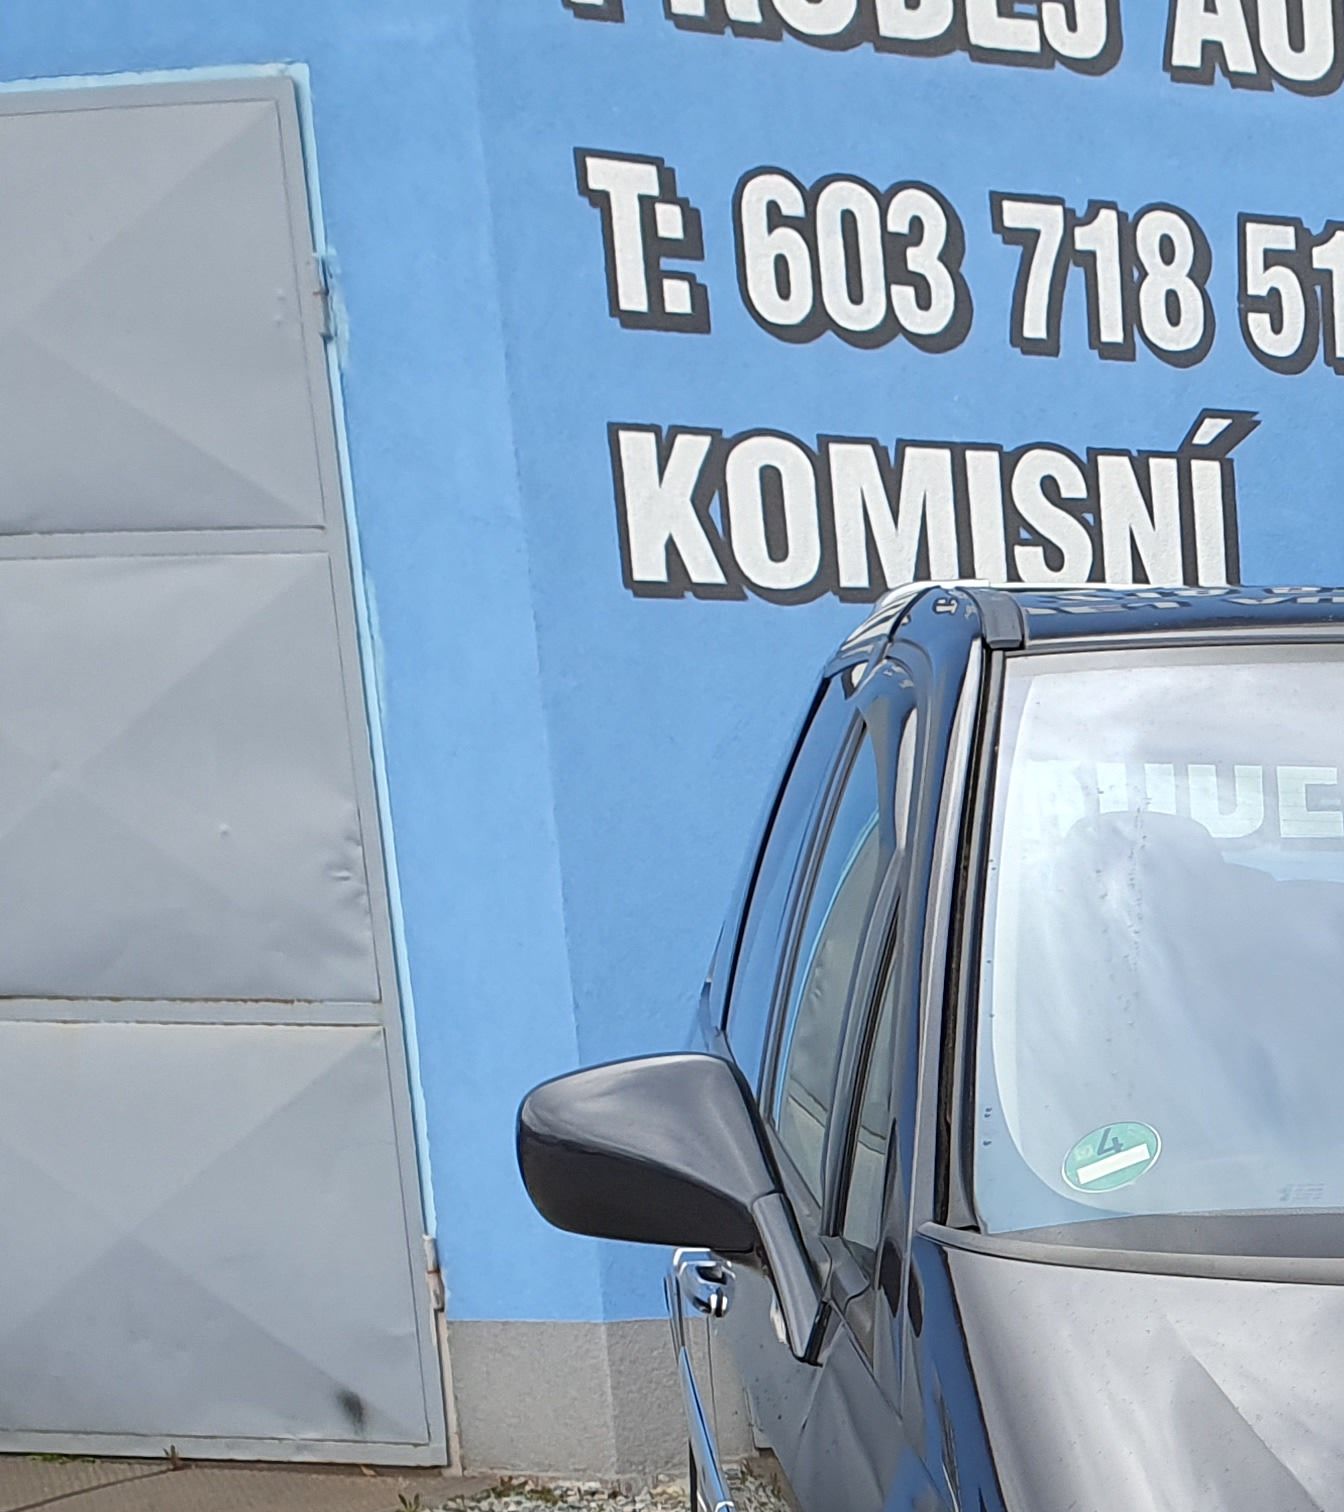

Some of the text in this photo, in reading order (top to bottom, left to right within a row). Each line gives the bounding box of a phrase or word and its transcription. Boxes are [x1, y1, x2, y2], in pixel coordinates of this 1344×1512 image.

[578, 150, 706, 332] T:
[738, 168, 969, 351] 603
[995, 193, 1211, 367] 718
[611, 410, 1260, 603] KOMISNÍ
